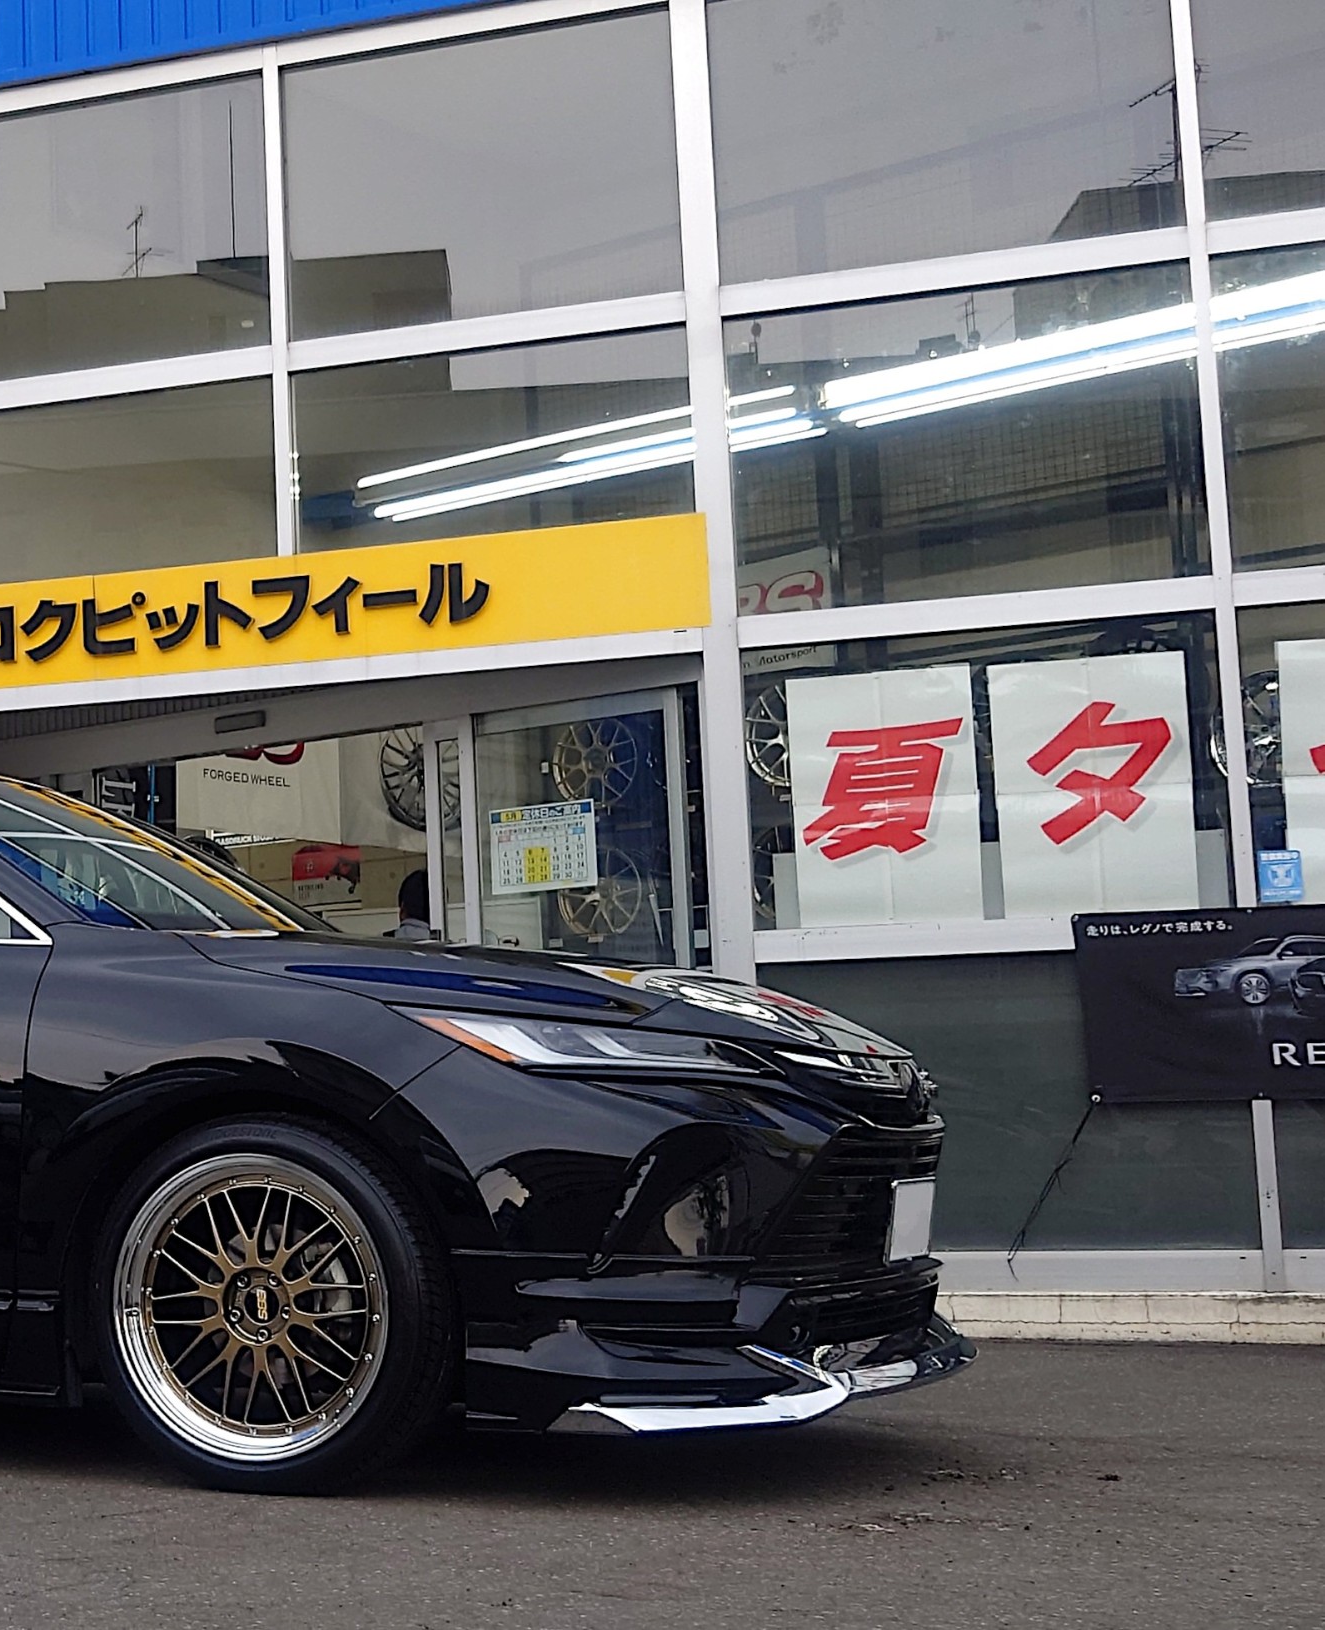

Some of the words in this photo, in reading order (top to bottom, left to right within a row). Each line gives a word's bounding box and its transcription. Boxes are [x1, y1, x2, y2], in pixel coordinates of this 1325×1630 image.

[203, 768, 249, 783] FORGED
[250, 774, 291, 788] WHEEL
[1086, 920, 1233, 937] 走りは、レグノで完成する。
